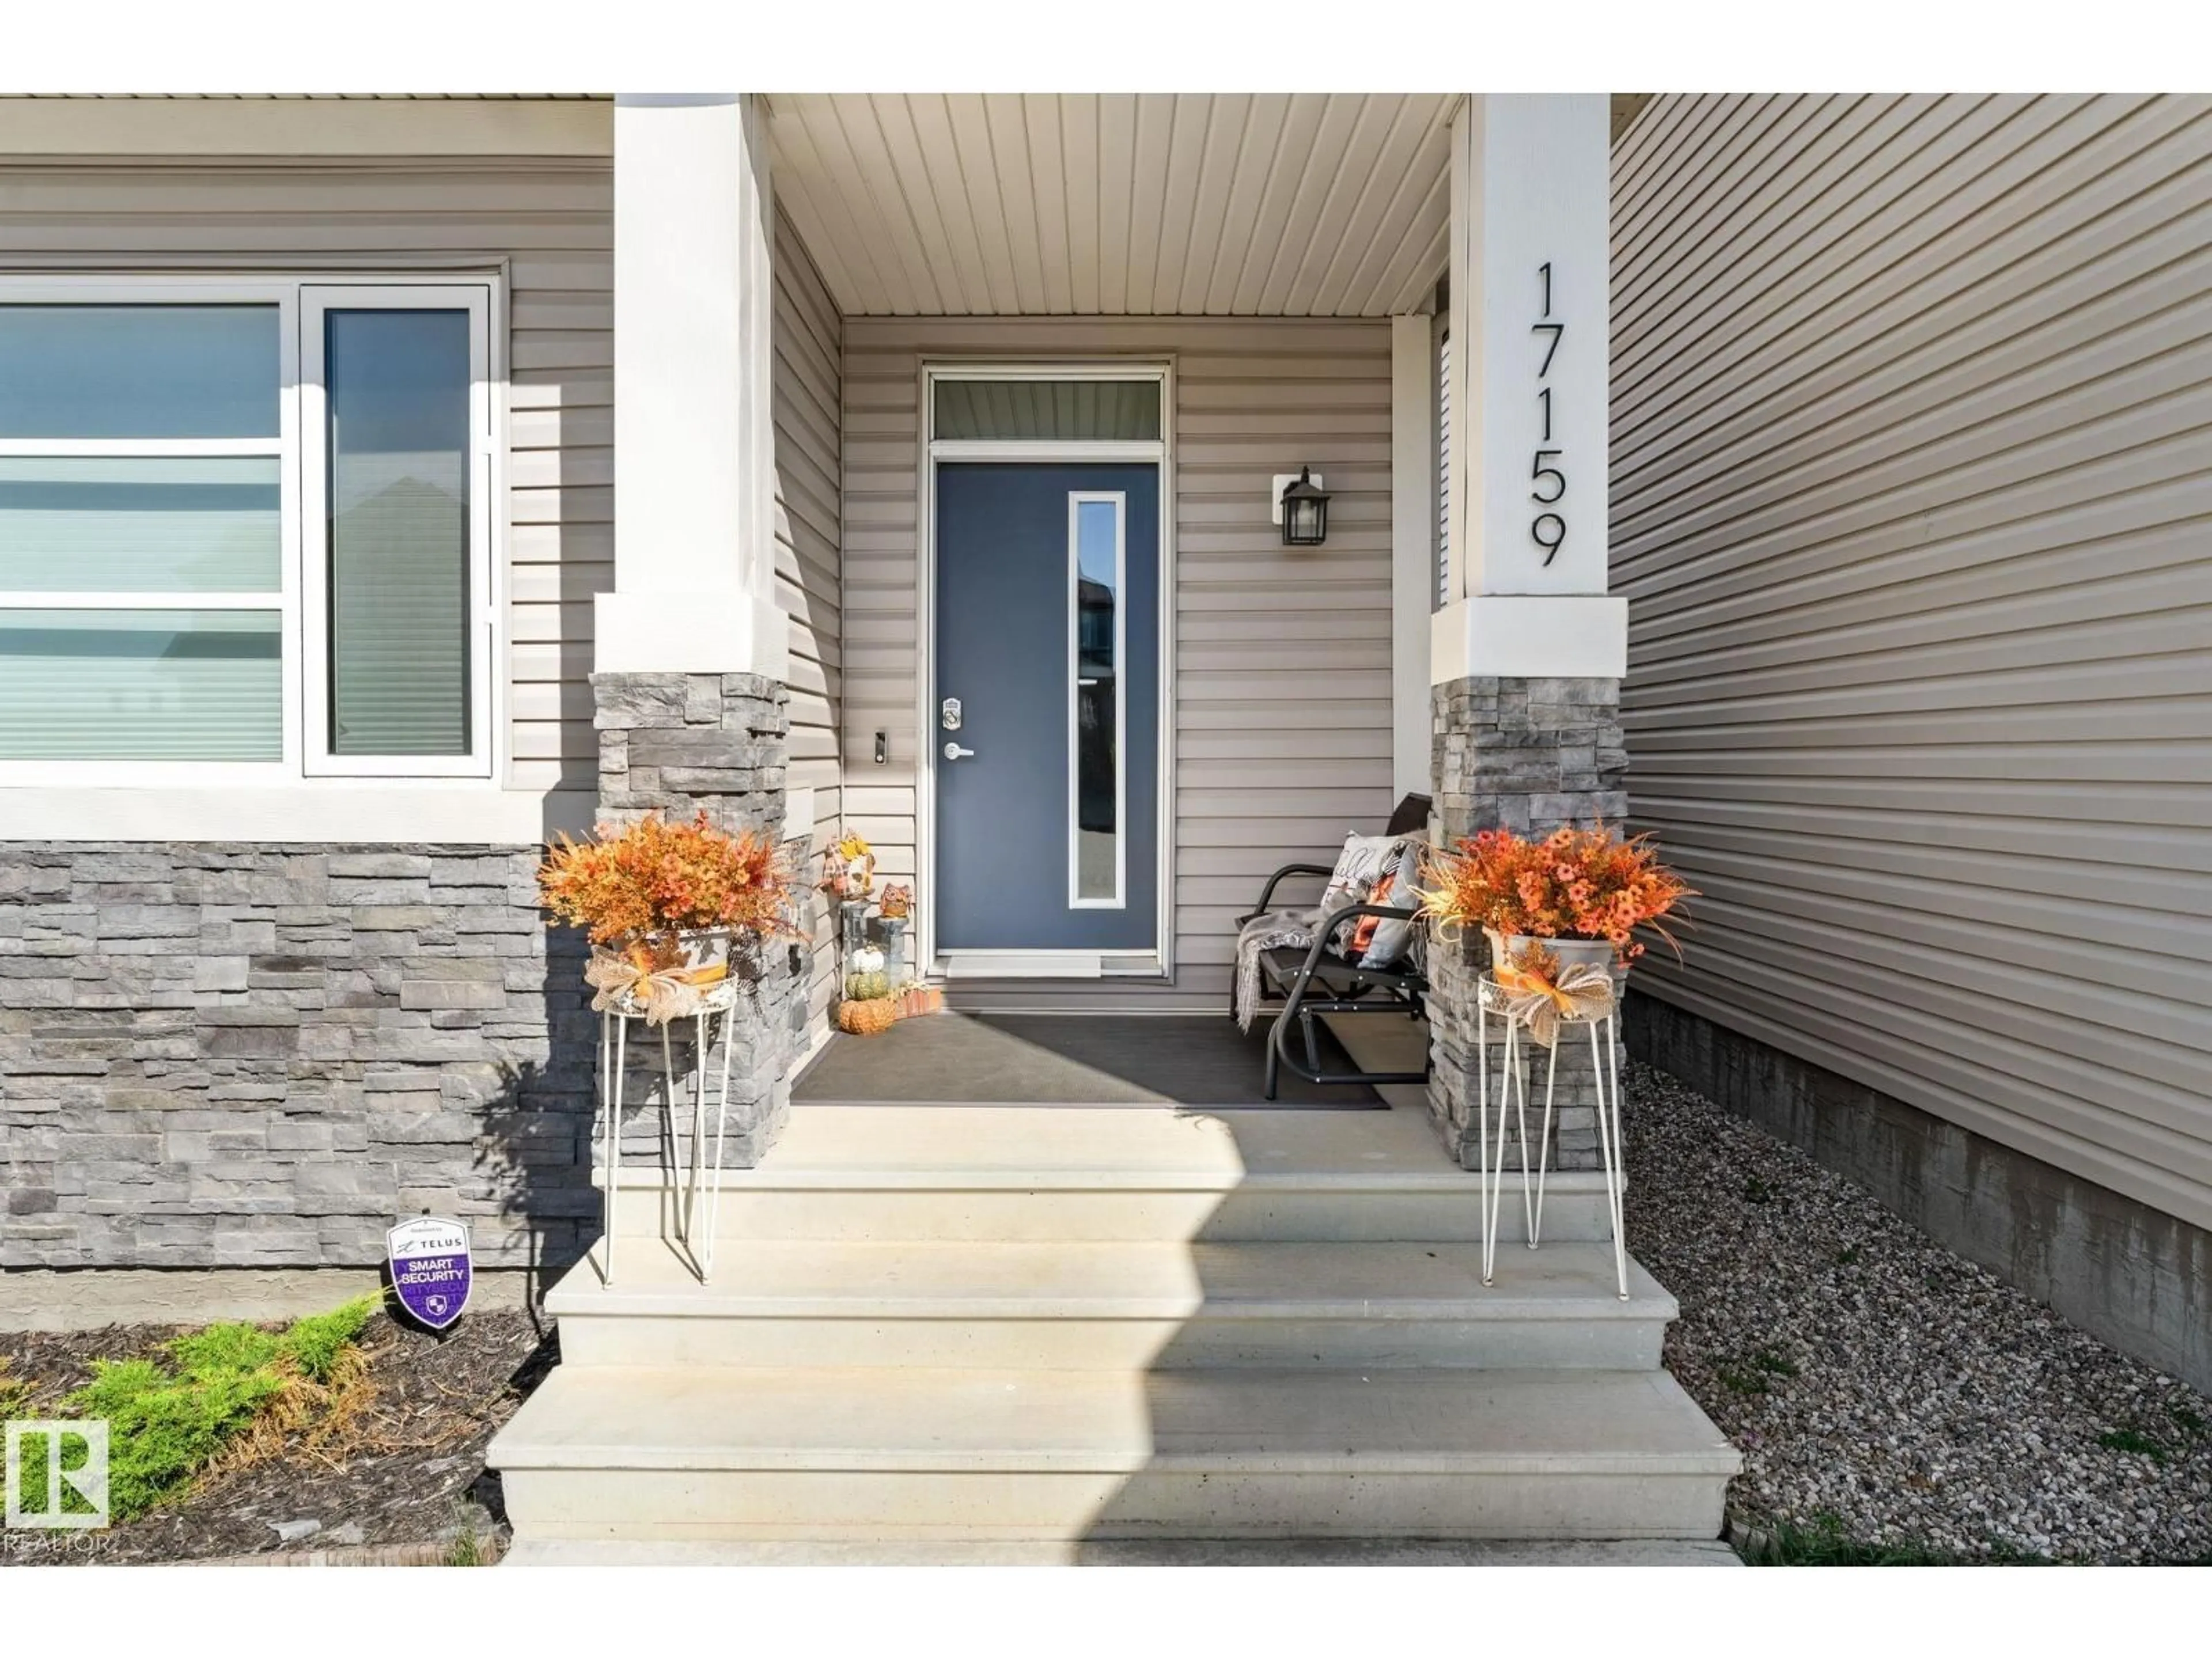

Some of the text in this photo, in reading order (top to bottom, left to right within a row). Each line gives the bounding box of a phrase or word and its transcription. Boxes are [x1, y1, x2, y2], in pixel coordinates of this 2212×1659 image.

[1531, 261, 1566, 567] 17159
[421, 1238, 462, 1248] TELUS
[408, 1259, 453, 1272] SMART
[402, 1270, 464, 1284] SECURITY
